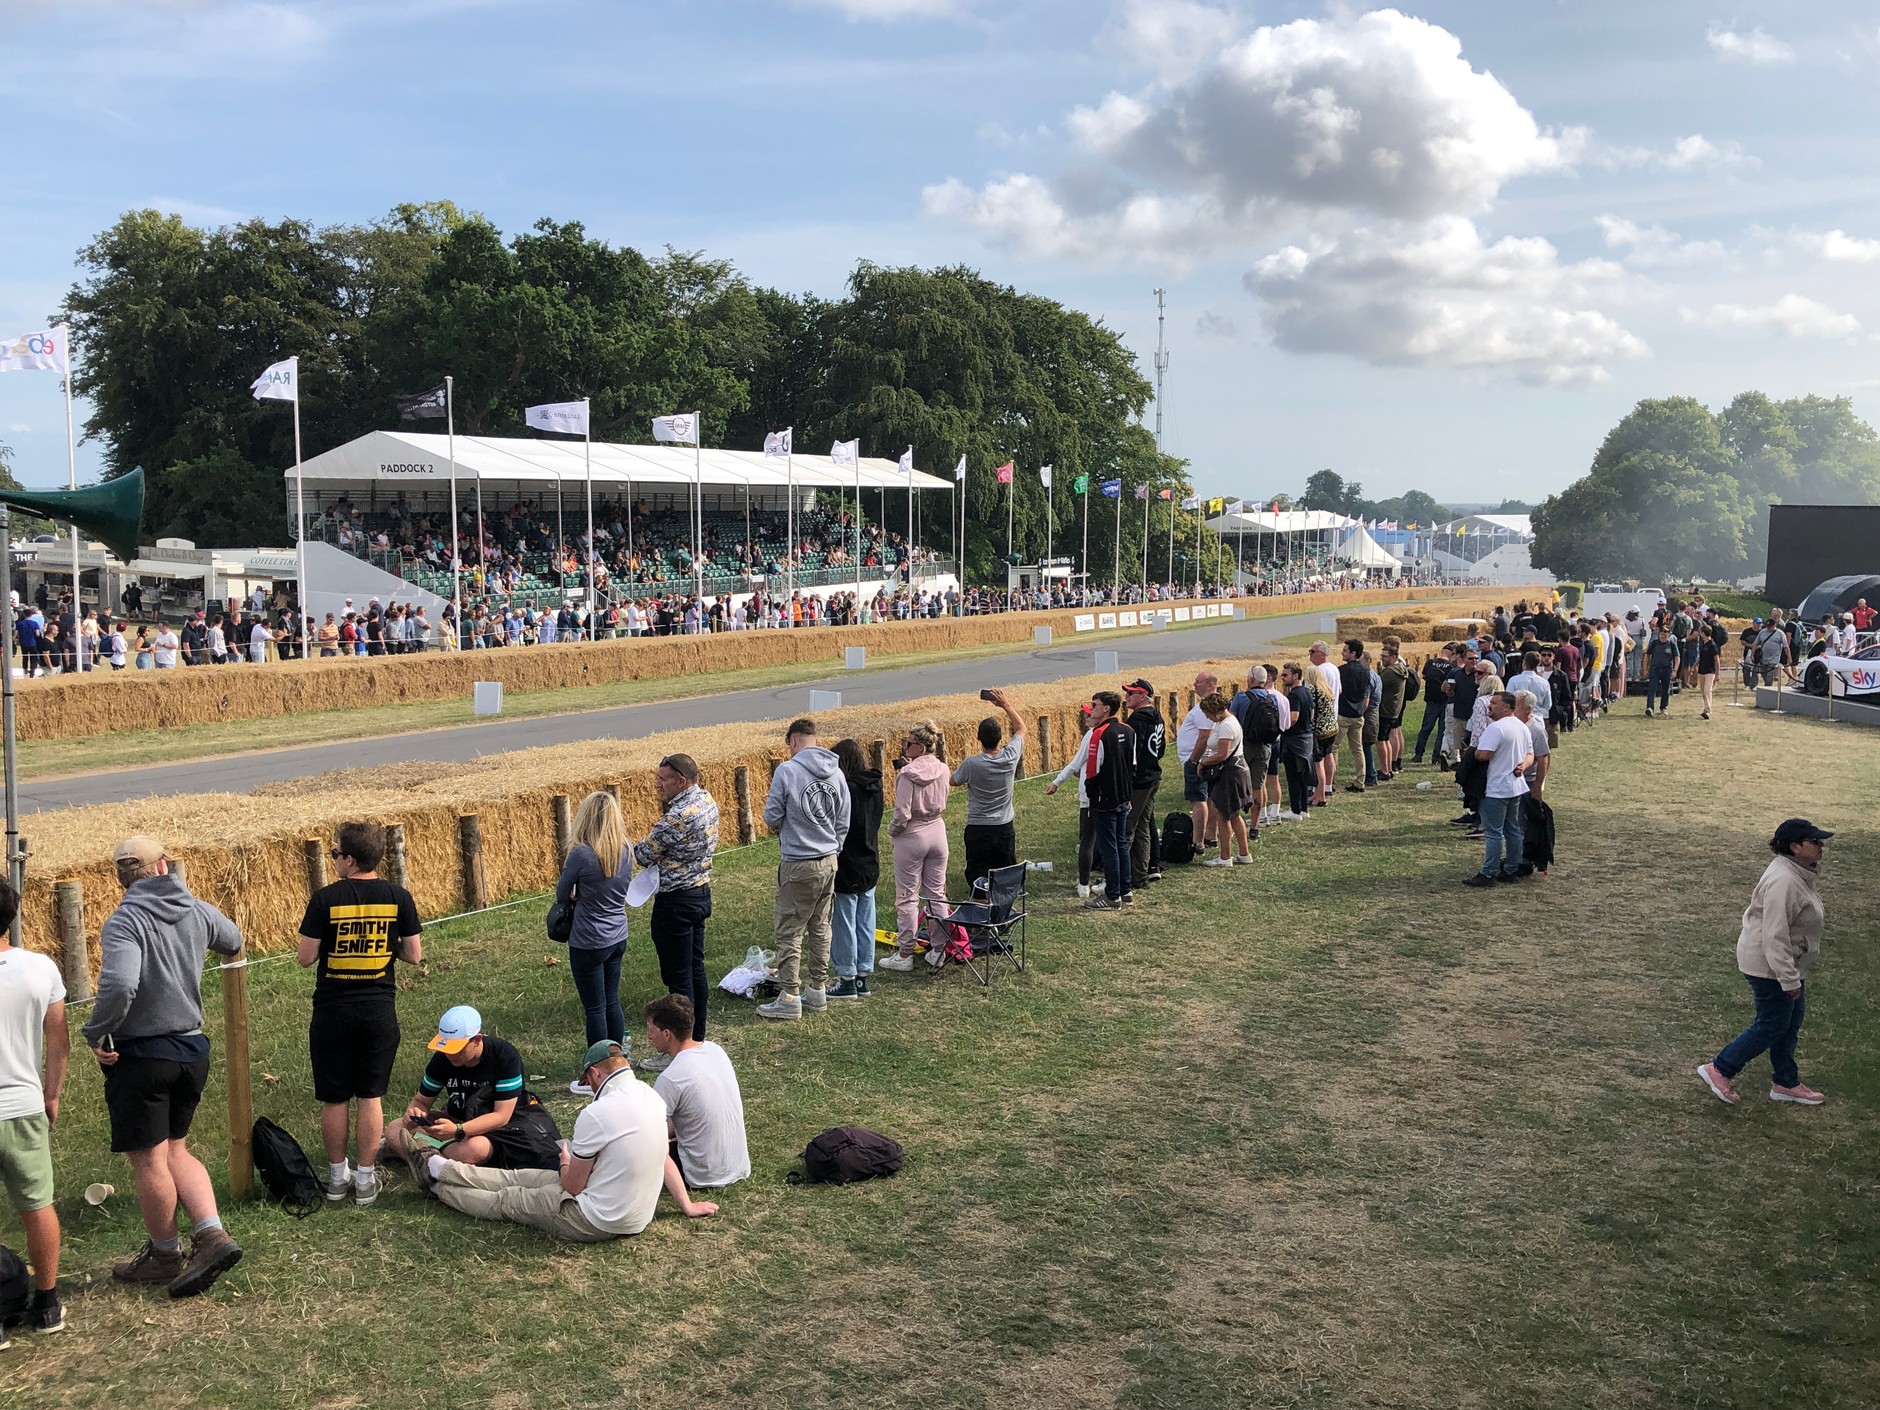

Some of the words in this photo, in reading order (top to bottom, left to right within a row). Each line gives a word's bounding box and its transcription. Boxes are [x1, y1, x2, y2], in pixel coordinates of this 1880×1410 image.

[380, 464, 426, 473] PADDOCK
[428, 464, 434, 473] 2
[15, 554, 33, 562] THE
[250, 557, 279, 566] COFFEE
[1852, 668, 1876, 689] sky
[806, 783, 837, 798] MERCIER
[339, 921, 387, 935] SMITH
[337, 939, 386, 953] SNIFF
